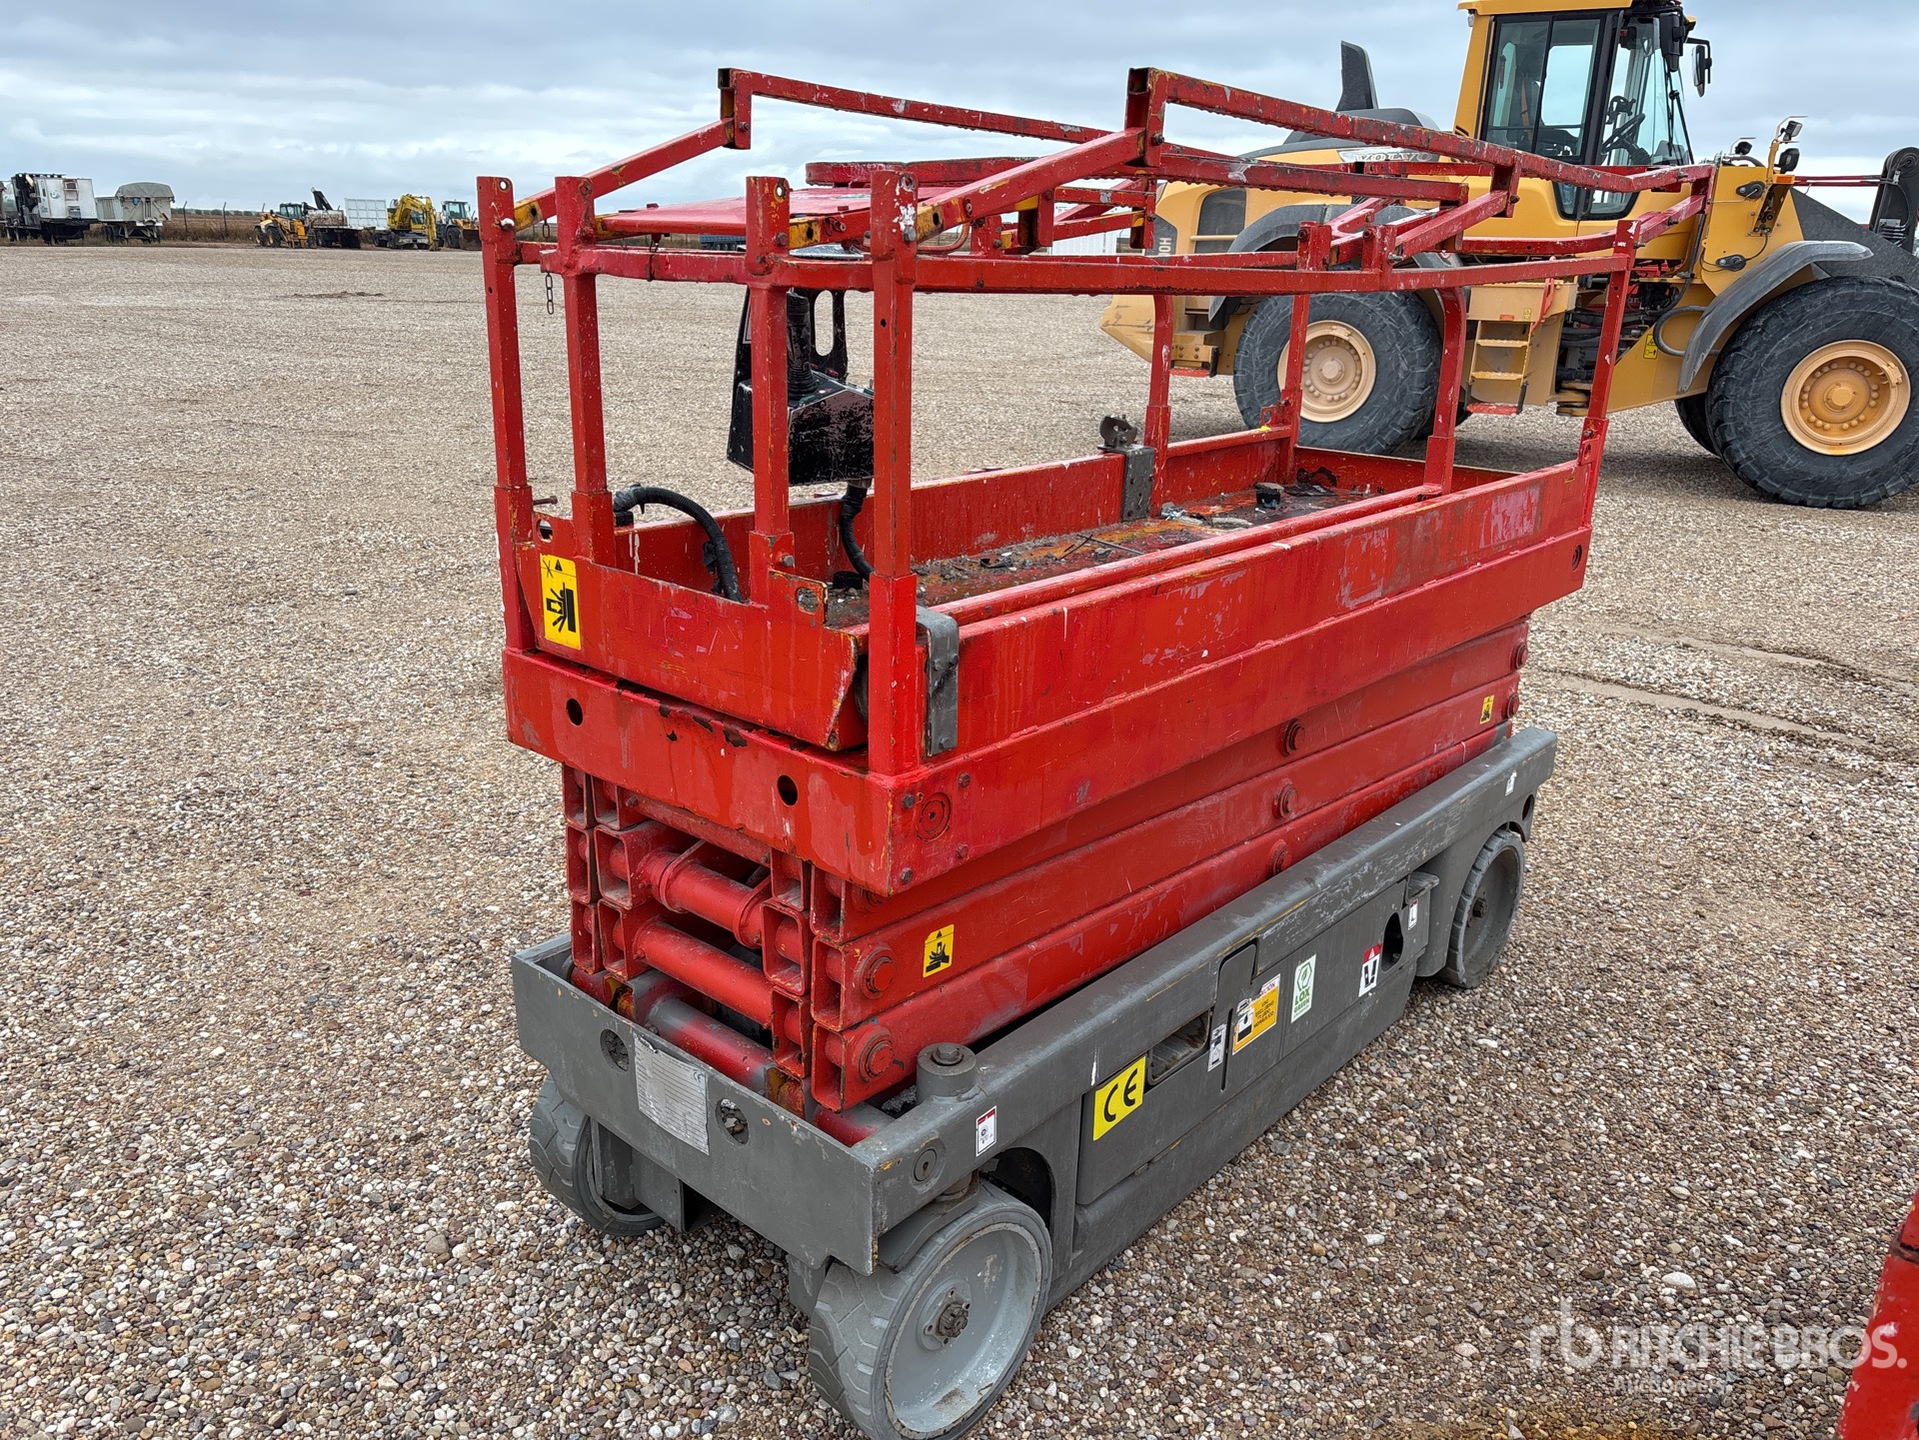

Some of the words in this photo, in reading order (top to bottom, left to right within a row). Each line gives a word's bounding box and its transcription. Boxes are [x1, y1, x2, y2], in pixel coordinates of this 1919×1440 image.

[1353, 151, 1432, 162] VOLVO
[1295, 985, 1310, 1006] LOX
[1103, 1067, 1138, 1123] CE
